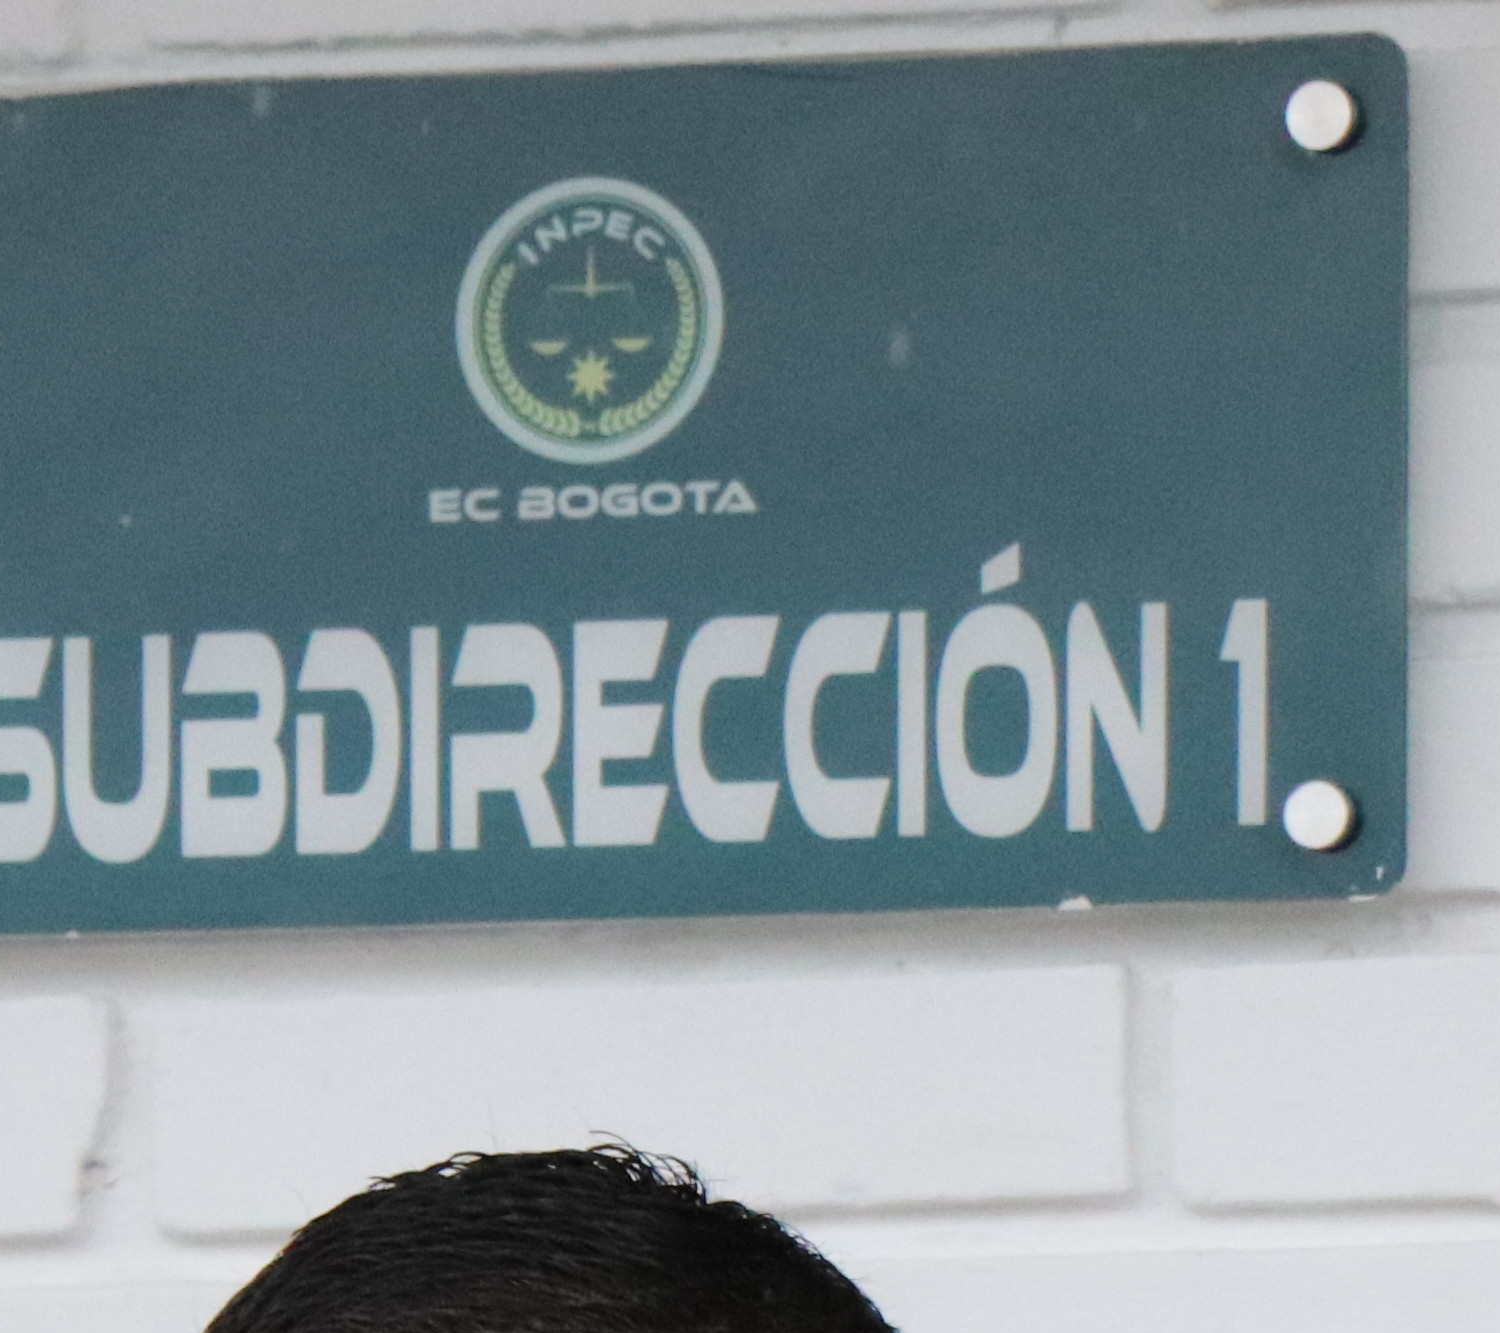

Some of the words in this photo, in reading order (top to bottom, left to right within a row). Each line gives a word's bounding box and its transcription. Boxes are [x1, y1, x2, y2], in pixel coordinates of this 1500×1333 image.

[516, 207, 666, 265] INPEC
[428, 489, 500, 523] EC
[517, 479, 758, 521] BOGOTA
[1220, 598, 1270, 827] 1
